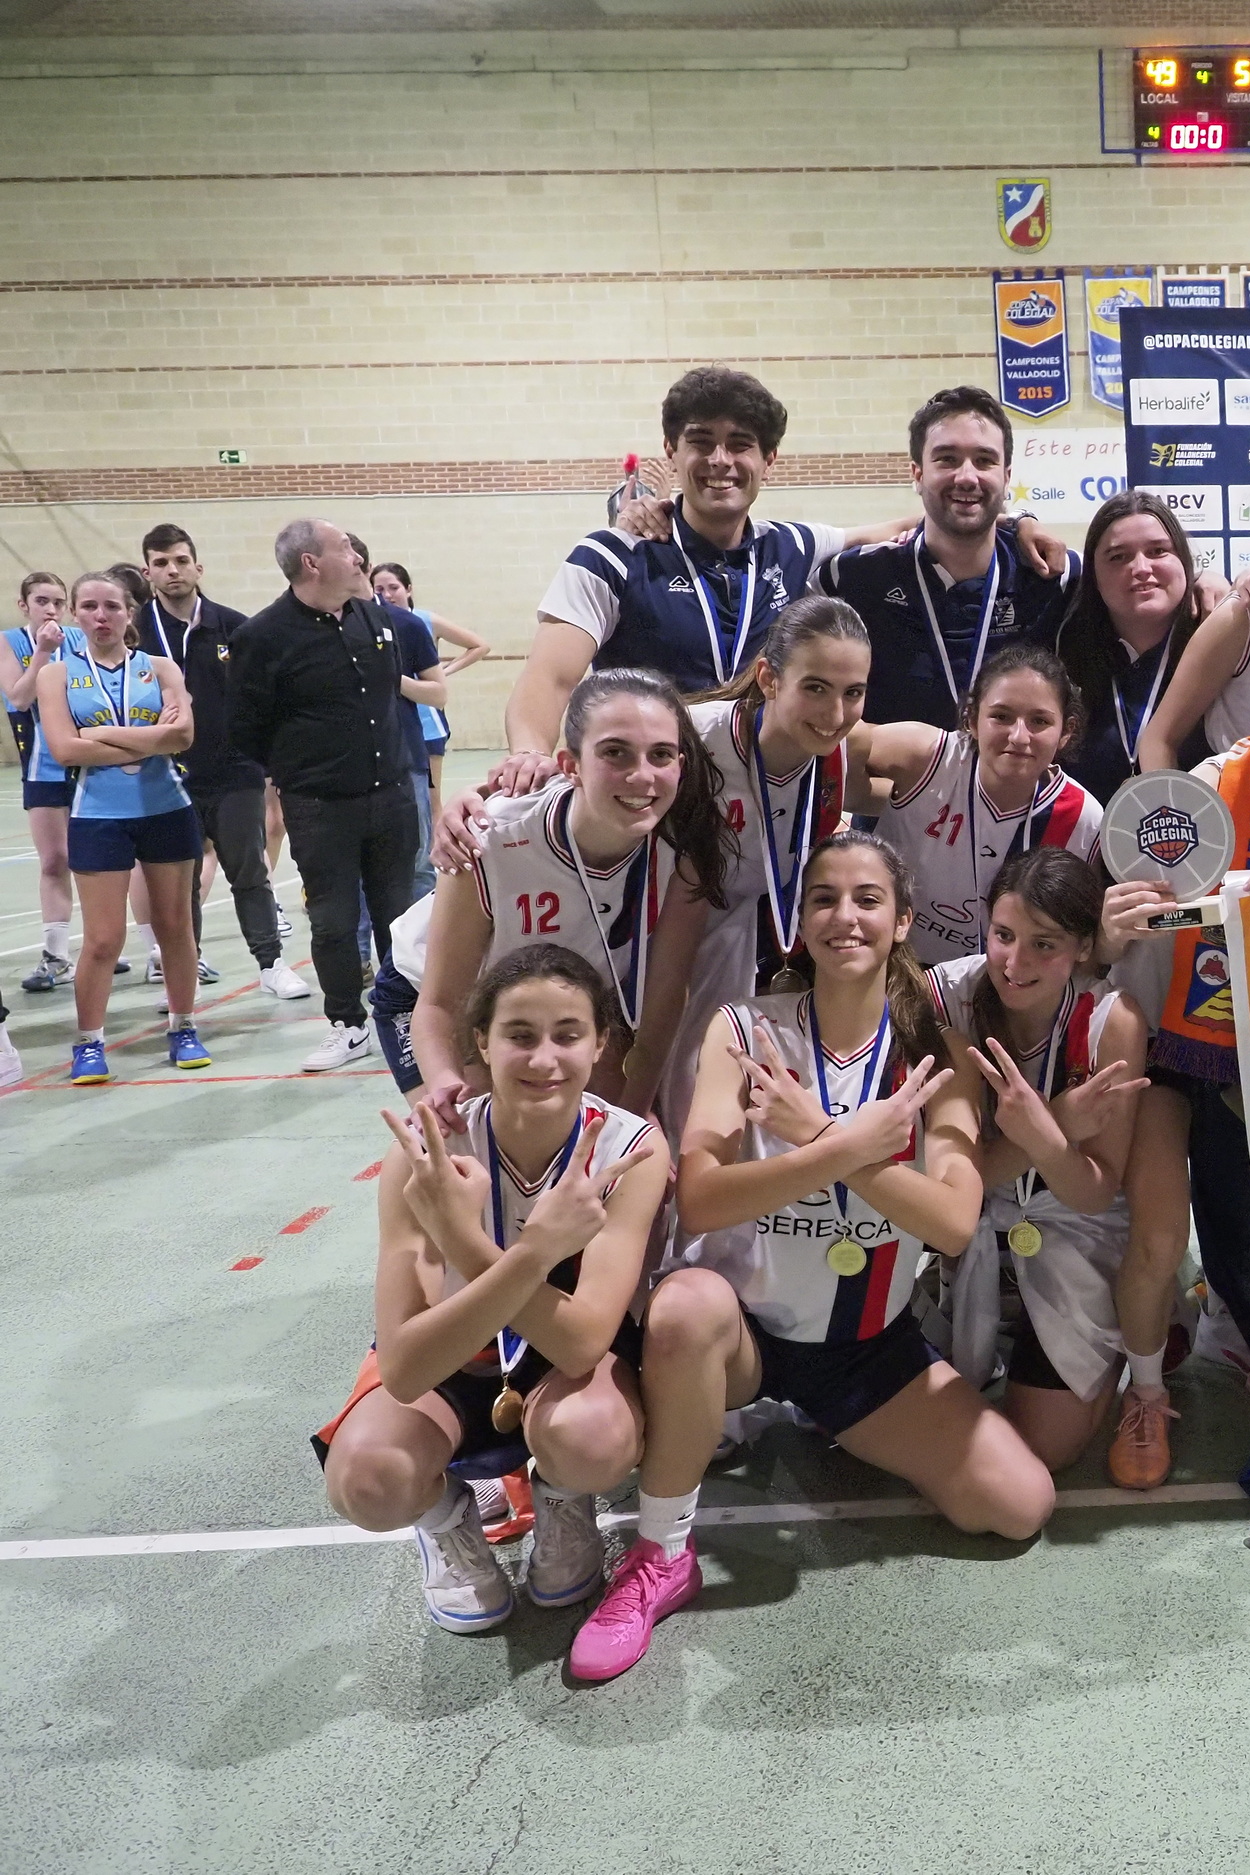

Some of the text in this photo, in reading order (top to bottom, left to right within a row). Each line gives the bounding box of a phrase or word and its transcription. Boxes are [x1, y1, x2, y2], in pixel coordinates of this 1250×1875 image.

[1146, 60, 1177, 86] 49
[1196, 71, 1209, 84] 4
[1140, 93, 1179, 104] LOCAL
[1148, 126, 1160, 139] 4
[1170, 125, 1223, 149] 00:0
[1167, 286, 1221, 295] CAMPEONES
[1009, 300, 1033, 310] COPA
[1168, 297, 1221, 307] VALLADOLID
[1004, 307, 1057, 320] COLEGIAL
[1005, 356, 1061, 366] CAMPEONES
[1006, 370, 1061, 379] VALLADOLID
[1018, 386, 1053, 400] 2015
[1138, 395, 1206, 412] Herbalife
[1025, 438, 1072, 457] Este
[1032, 487, 1066, 500] Salle
[70, 675, 95, 688] 11
[924, 804, 964, 846] 21
[1151, 816, 1179, 829] COPA
[1140, 827, 1196, 848] COLEGIAL
[515, 891, 561, 936] 12
[1163, 910, 1185, 920] MVP
[756, 1215, 892, 1240] SERESCA
